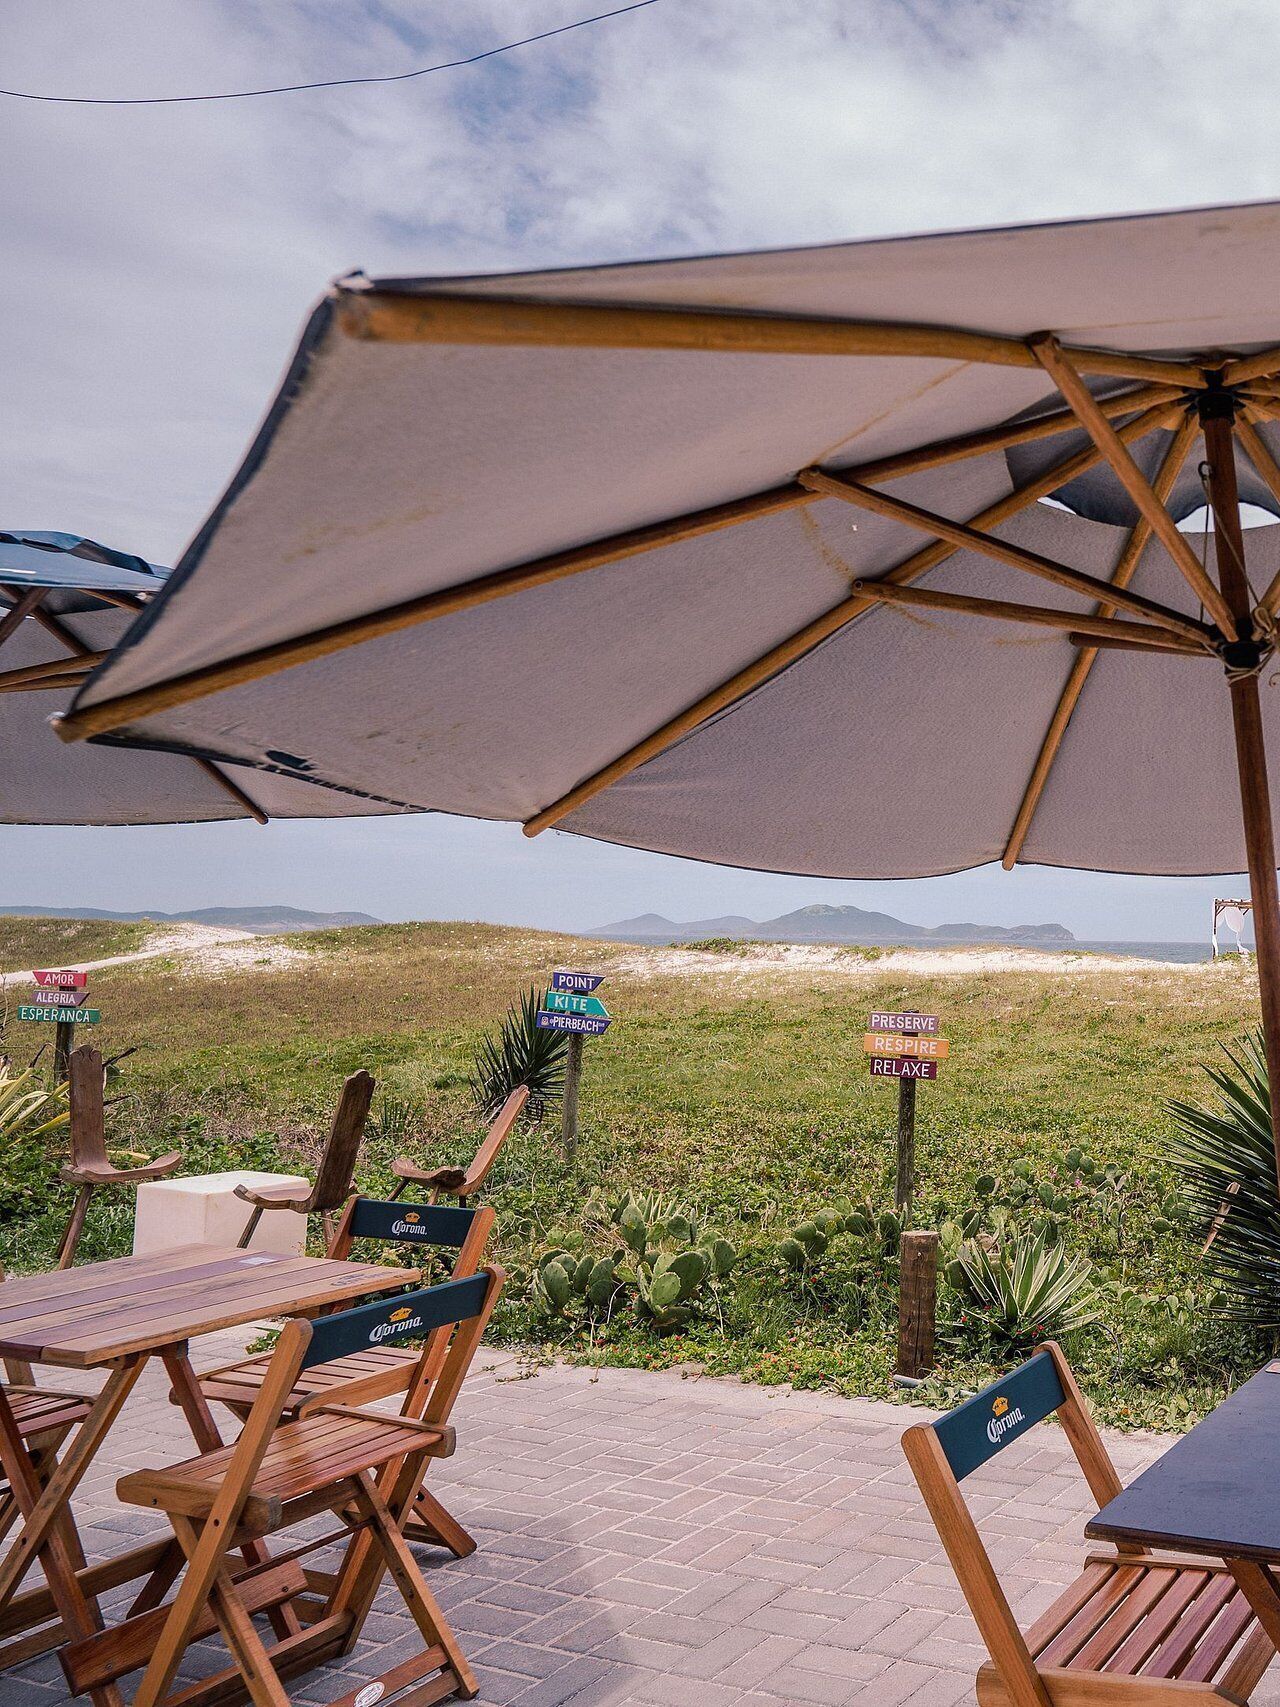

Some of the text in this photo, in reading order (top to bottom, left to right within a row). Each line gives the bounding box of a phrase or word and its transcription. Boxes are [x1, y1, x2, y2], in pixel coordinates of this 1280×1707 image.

[44, 974, 74, 984] AMOR
[558, 975, 595, 989] POINT
[36, 992, 76, 1004] ALEGRIA
[554, 995, 588, 1011] KITE
[871, 1014, 935, 1030] PRESERVE
[874, 1037, 938, 1055] RESPIRE
[873, 1059, 931, 1077] RELAXE
